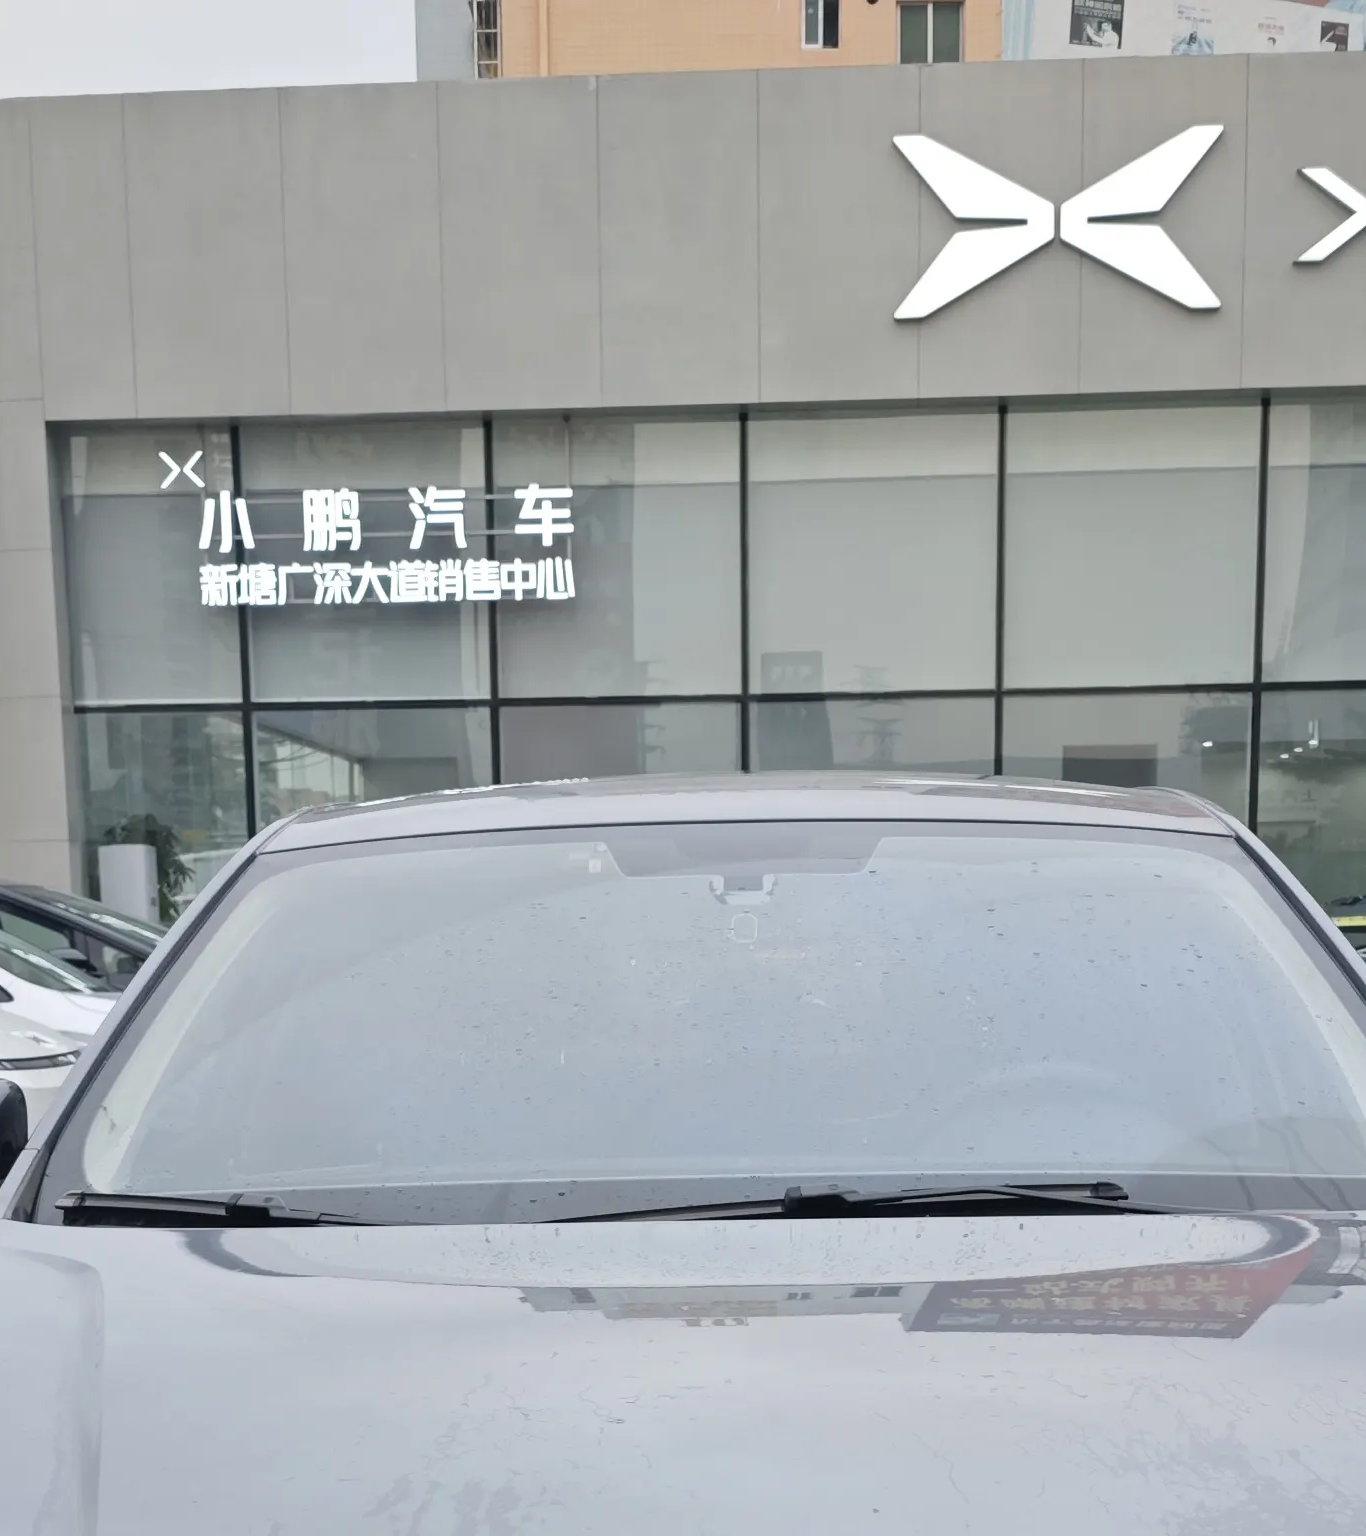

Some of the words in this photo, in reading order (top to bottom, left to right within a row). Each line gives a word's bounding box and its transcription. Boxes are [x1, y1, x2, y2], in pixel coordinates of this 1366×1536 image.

[199, 482, 575, 554] 小鹏汽车
[199, 556, 576, 606] 新塘广深大道销售中心
